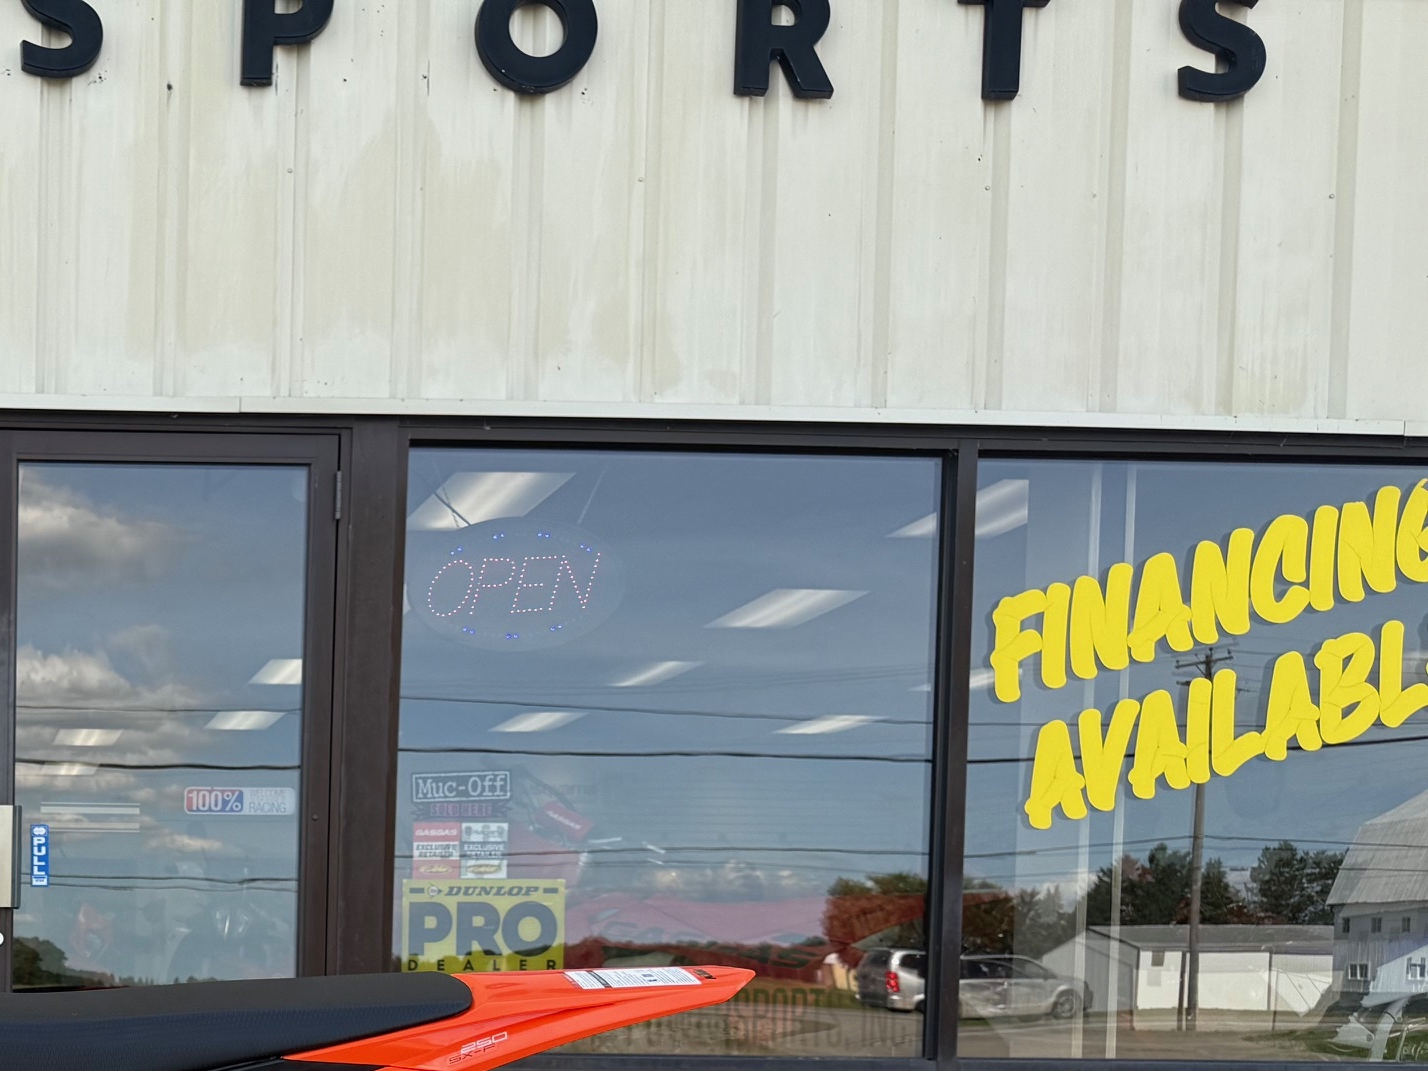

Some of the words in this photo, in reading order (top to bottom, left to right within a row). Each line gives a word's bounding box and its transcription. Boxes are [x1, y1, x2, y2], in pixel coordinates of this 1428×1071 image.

[428, 552, 601, 618] OPEN
[1024, 620, 1428, 829] AVAILABL
[417, 776, 508, 798] Muc-Off
[187, 790, 242, 812] 100%
[248, 802, 287, 813] RACING
[32, 836, 47, 875] PULL
[445, 886, 540, 897] DUNLOP
[409, 900, 558, 958] PRO
[407, 959, 557, 971] DEALER
[460, 1031, 508, 1055] 250
